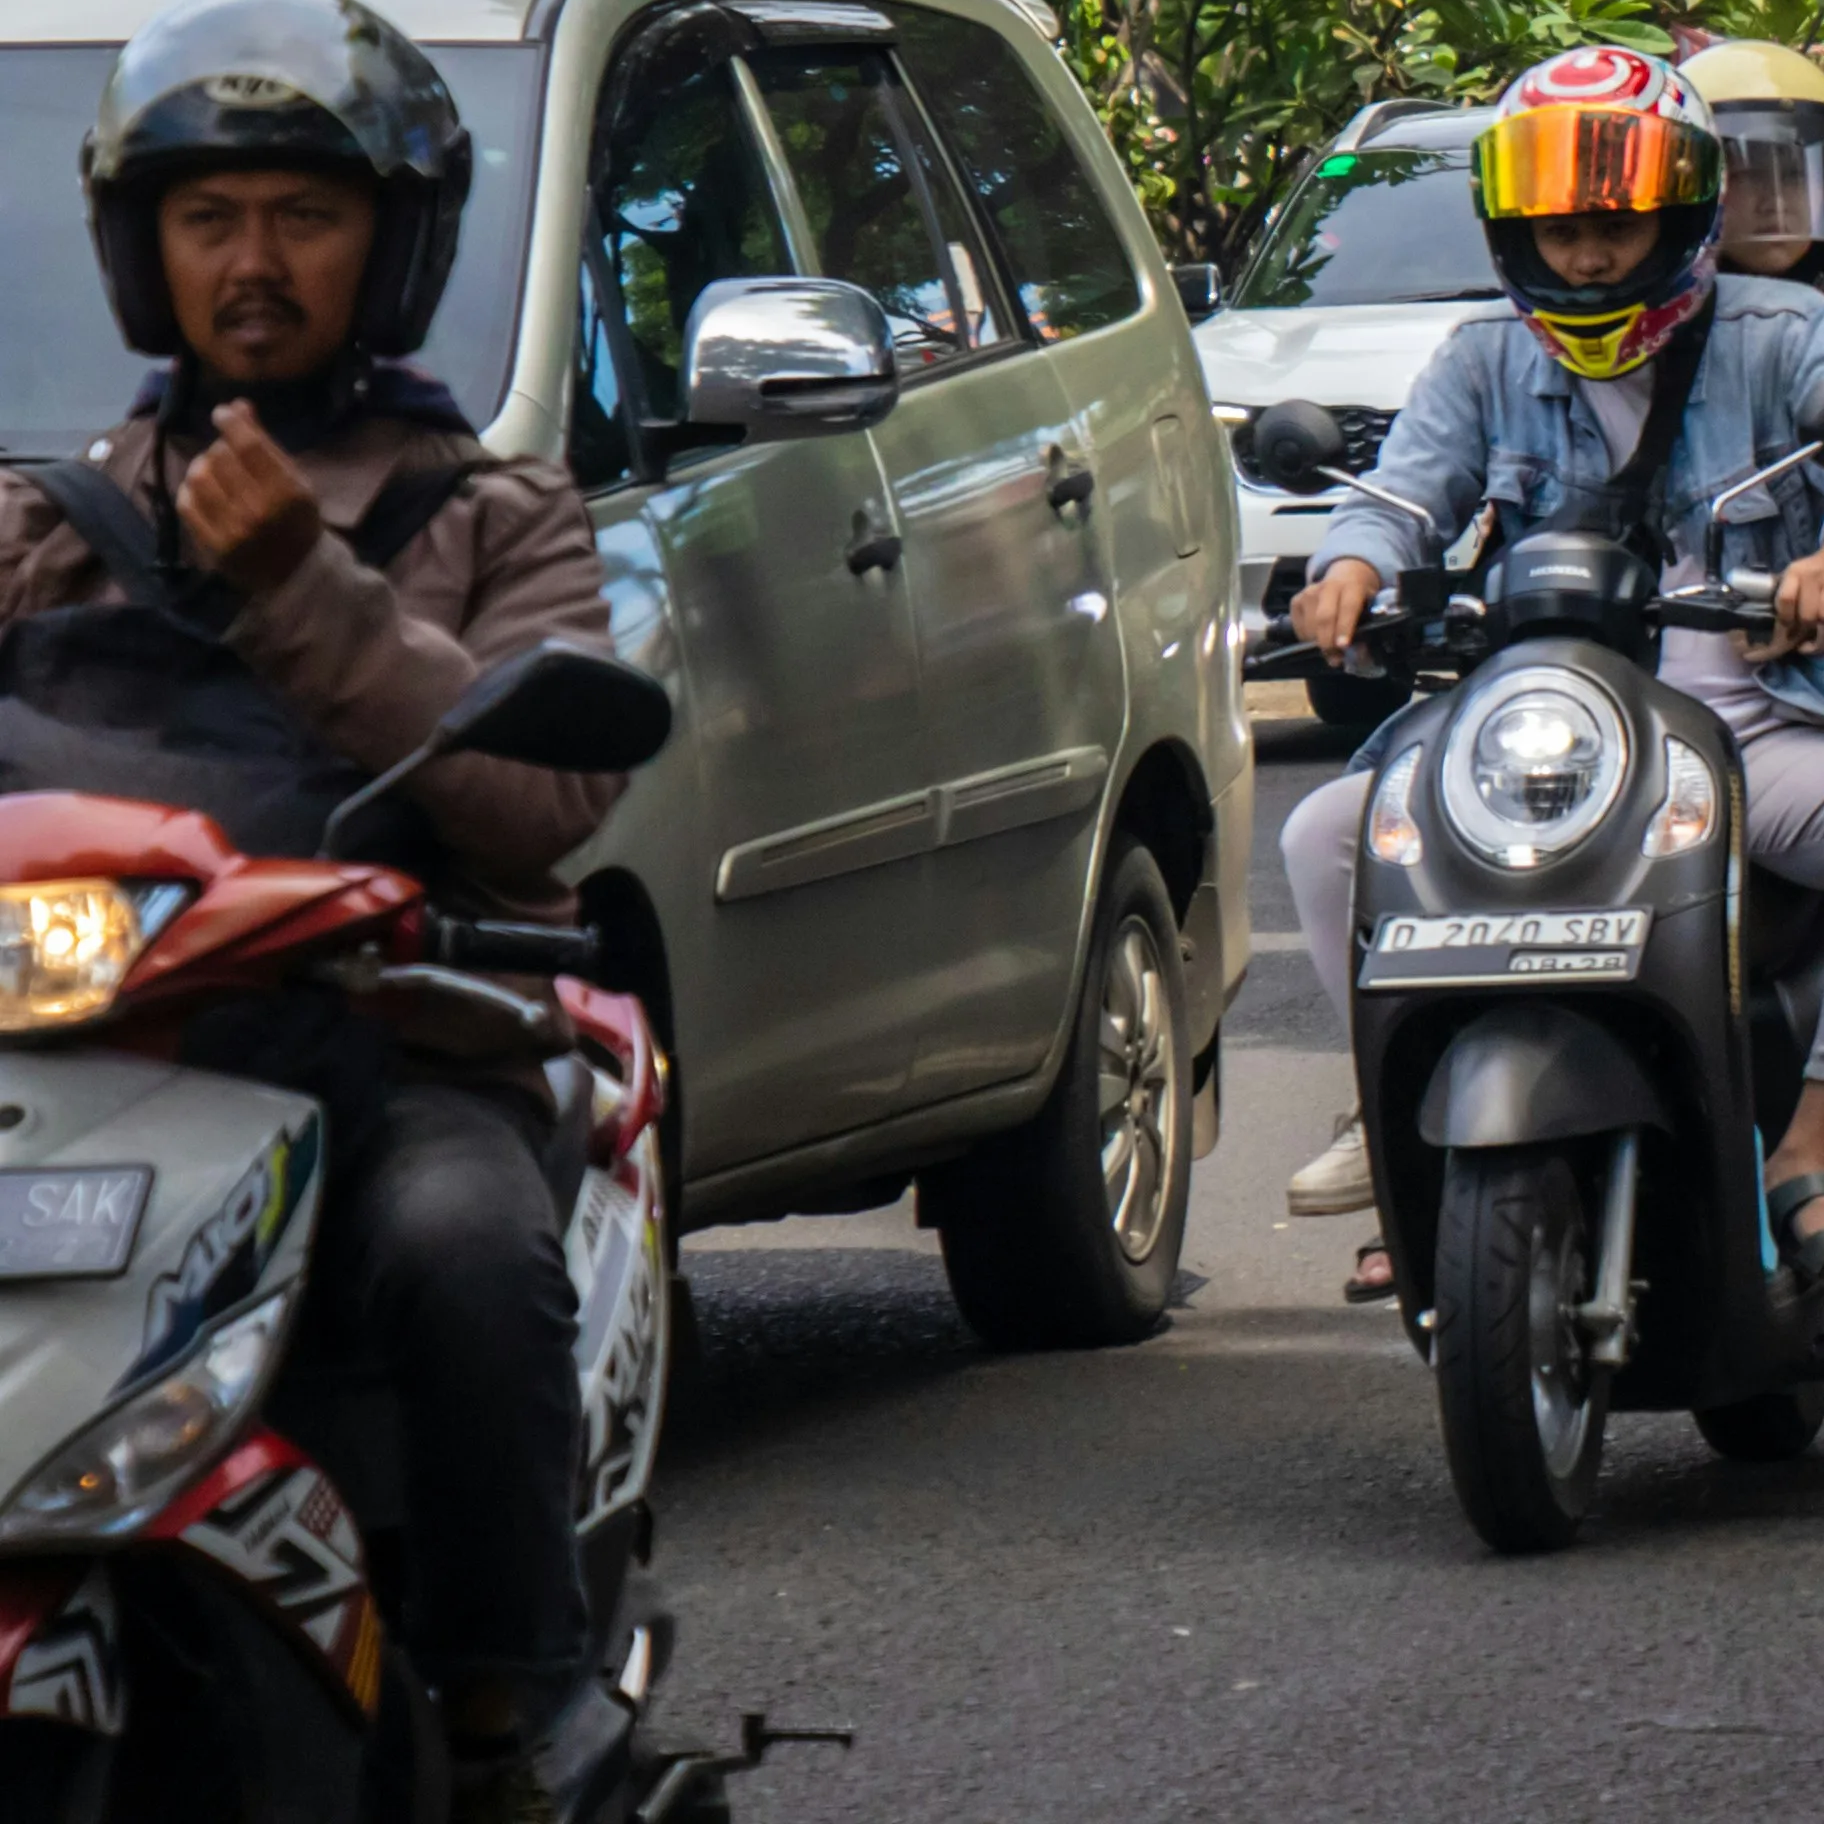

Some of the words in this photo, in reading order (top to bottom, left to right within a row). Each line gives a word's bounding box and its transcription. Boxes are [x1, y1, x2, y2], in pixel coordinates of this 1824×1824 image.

[1392, 924, 1417, 950] D
[1562, 916, 1637, 945] SBV
[23, 1178, 131, 1227] SAK
